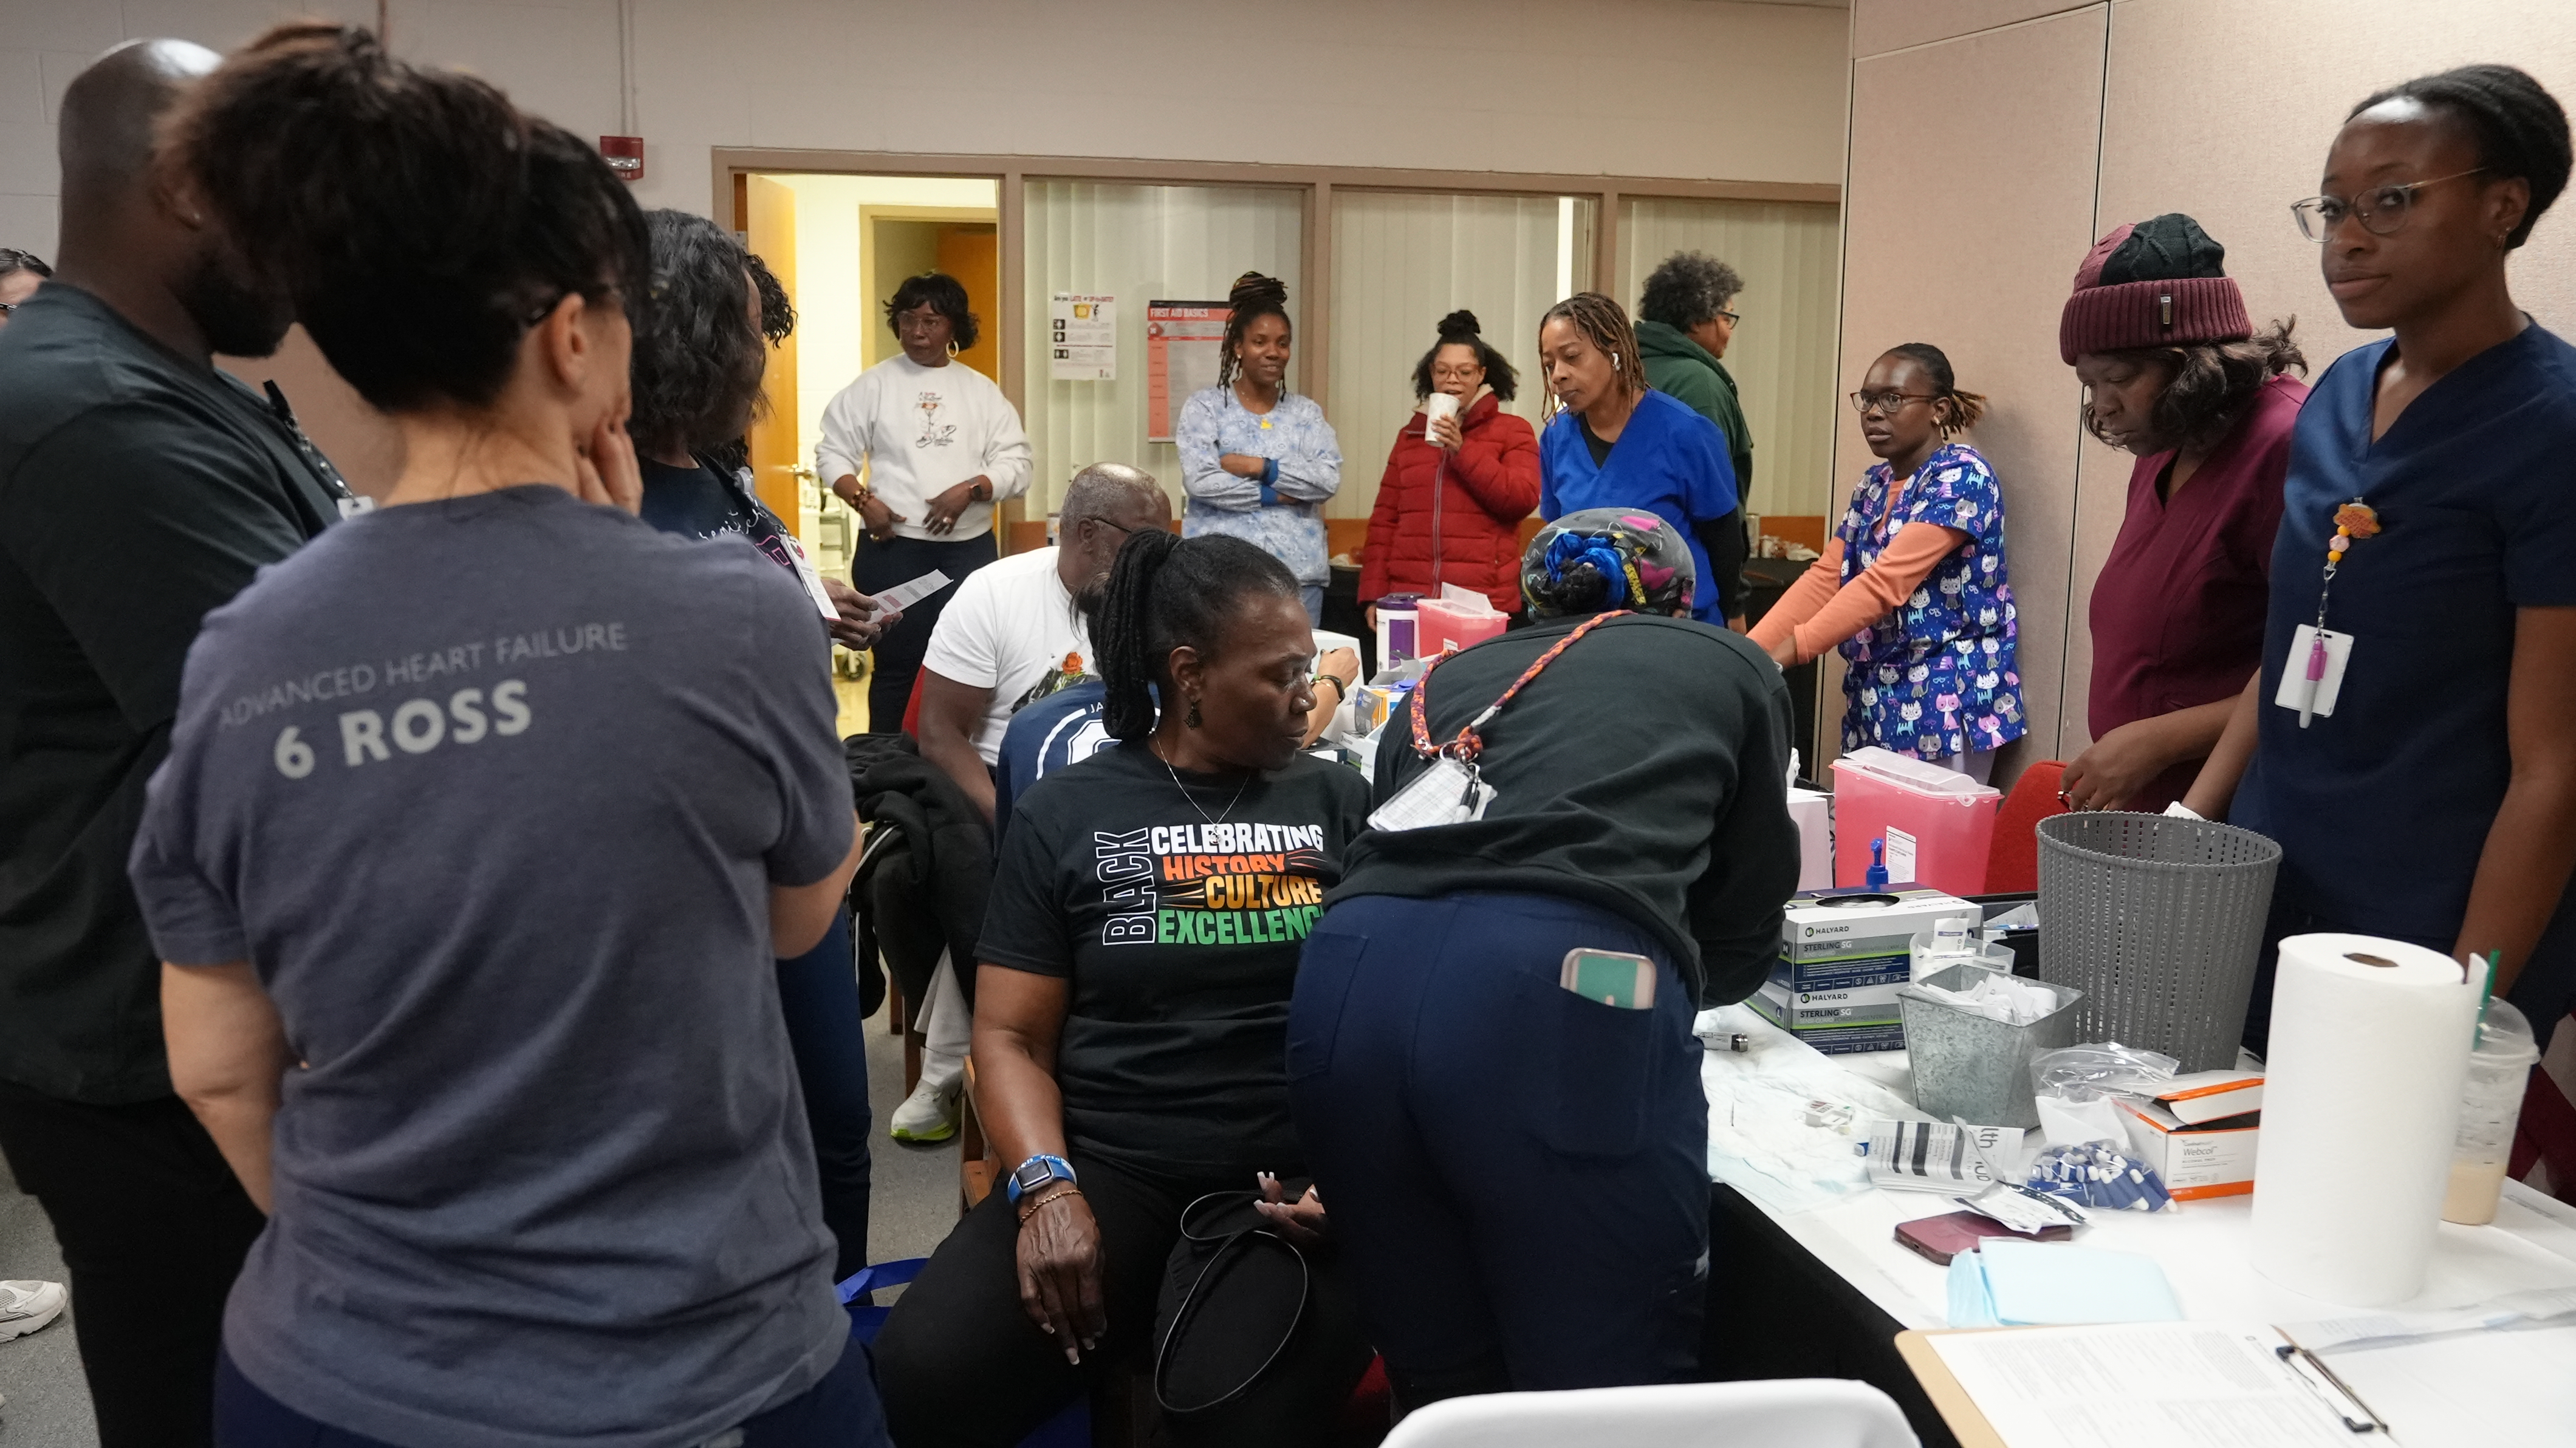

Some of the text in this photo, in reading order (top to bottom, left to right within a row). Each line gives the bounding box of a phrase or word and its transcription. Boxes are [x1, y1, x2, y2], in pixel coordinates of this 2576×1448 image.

[1150, 308, 1209, 318] FIRST AID BASICS
[219, 623, 628, 727] ADVANCED HEART FAILURE
[1090, 702, 1104, 714] JA
[274, 679, 531, 779] 6 ROSS
[1151, 823, 1324, 856] CELEBRATING
[1162, 853, 1286, 881] HISTORY
[1094, 827, 1157, 946] BLACK
[1205, 876, 1322, 909] CULTURE
[1158, 906, 1326, 945] EXCELLENC
[1804, 941, 1840, 952] STERLING
[1800, 1009, 1839, 1018] STERLING
